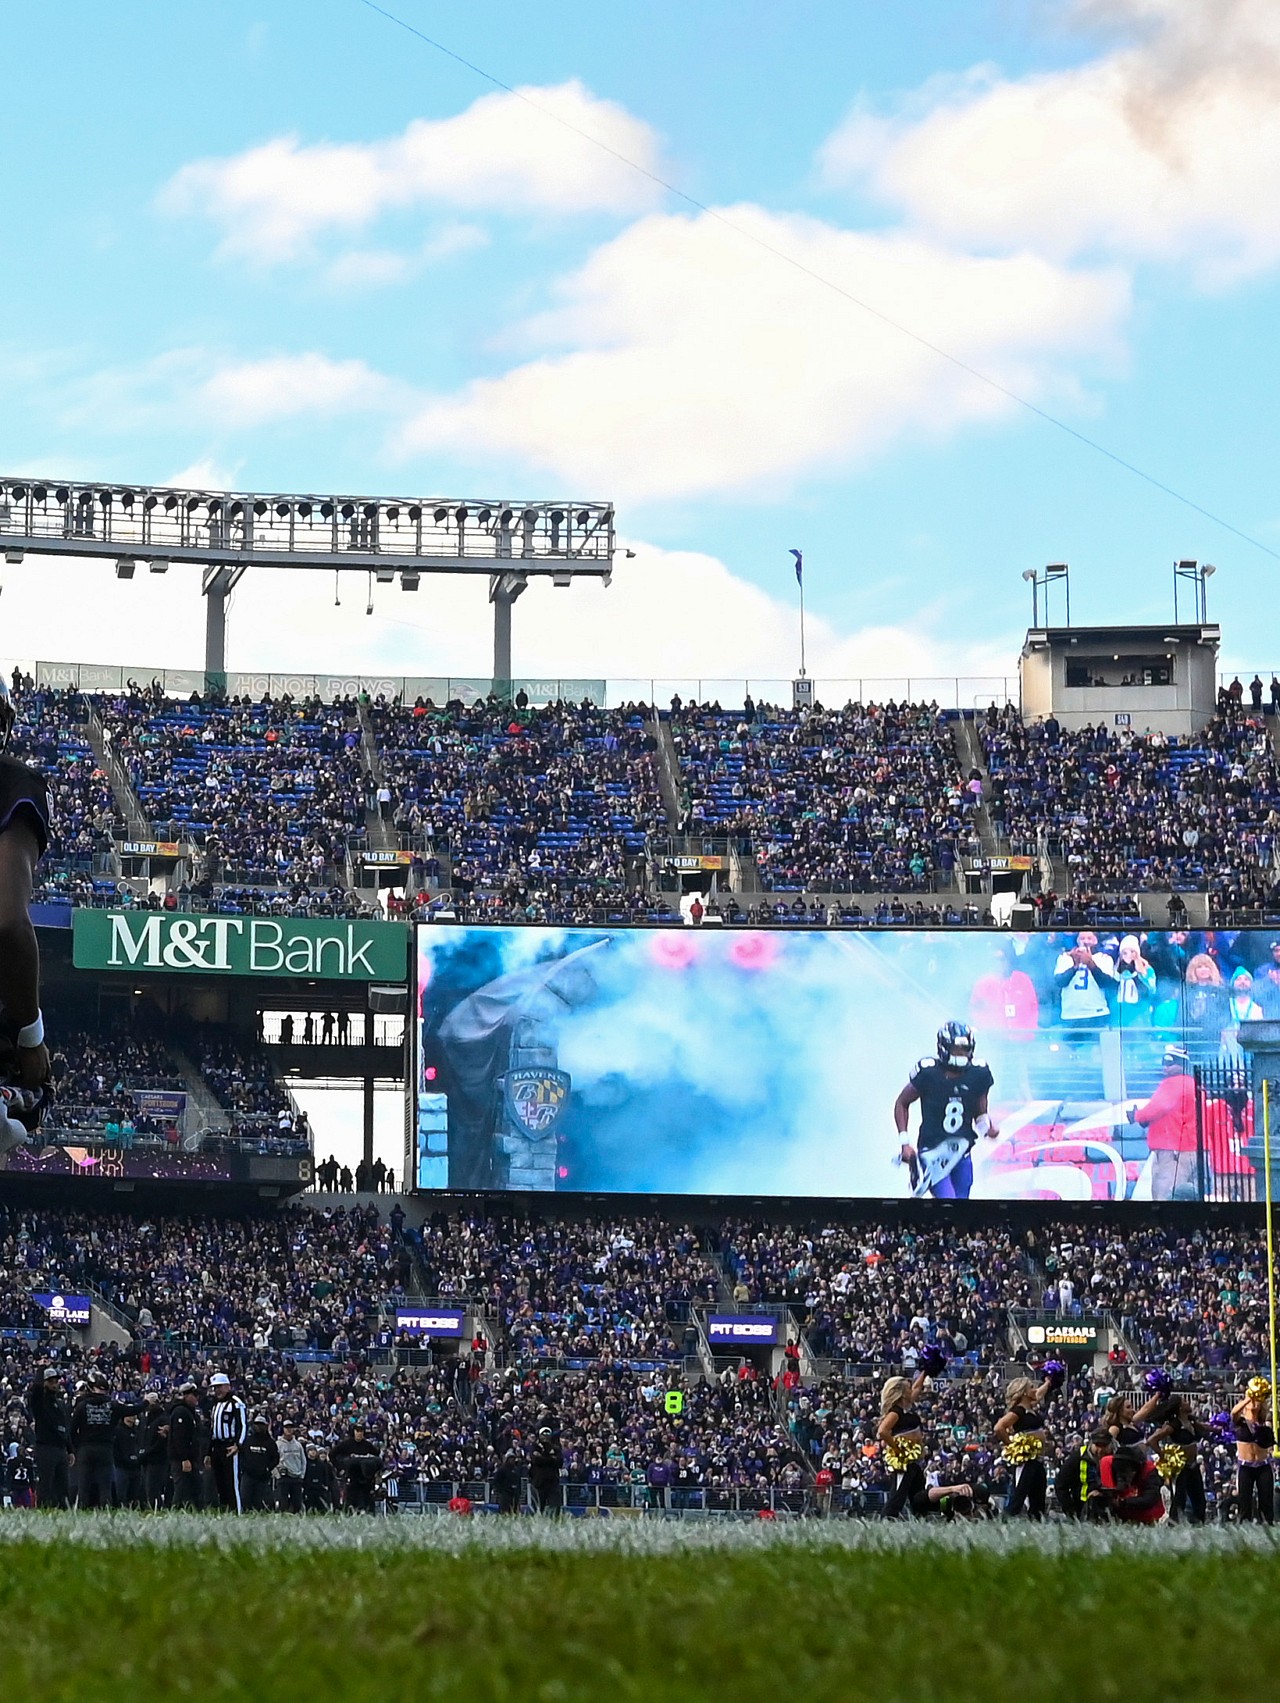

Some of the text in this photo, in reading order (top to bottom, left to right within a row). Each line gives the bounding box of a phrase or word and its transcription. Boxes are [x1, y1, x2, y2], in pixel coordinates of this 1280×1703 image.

[80, 669, 113, 683] Bank
[564, 684, 599, 698] Bank
[123, 842, 155, 853] OLD BAY
[378, 853, 393, 862] BAY
[681, 858, 697, 867] BAY
[973, 858, 1007, 868] OL BAY
[107, 914, 375, 975] M&T Bank
[943, 1101, 964, 1134] 8
[297, 1159, 312, 1181] 8
[397, 1317, 459, 1329] PIT BOSS
[710, 1323, 773, 1336] PIT BOSS
[1045, 1326, 1096, 1338] CAESARS
[1046, 1336, 1087, 1344] SPORTSBOOK
[665, 1391, 683, 1413] 8
[14, 1468, 27, 1480] 23
